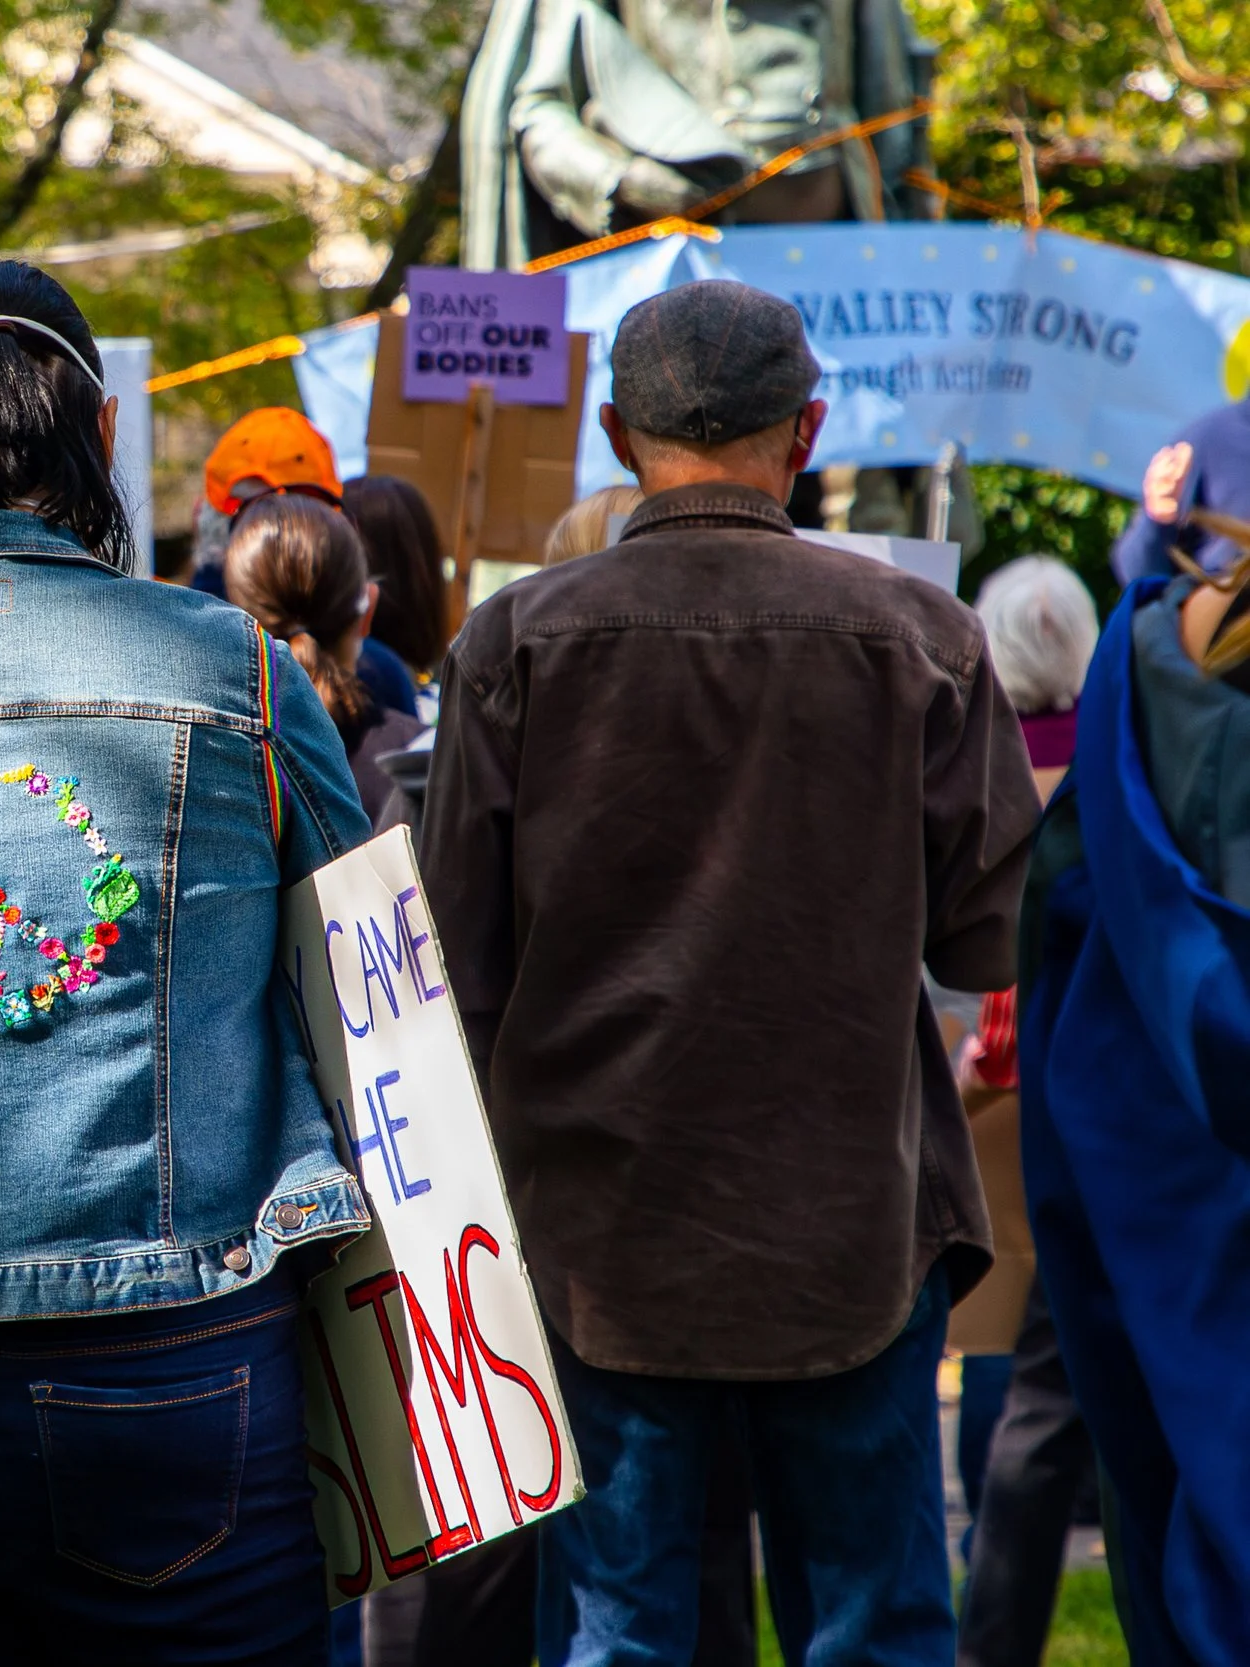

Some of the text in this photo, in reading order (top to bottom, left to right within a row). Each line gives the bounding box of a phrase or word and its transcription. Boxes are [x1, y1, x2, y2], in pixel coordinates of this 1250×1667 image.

[418, 292, 498, 317] BANS
[417, 321, 550, 349] OFF OUR
[792, 288, 1140, 367] VALLEY STRONG
[416, 353, 533, 377] BODIES
[325, 884, 447, 1039] CAME
